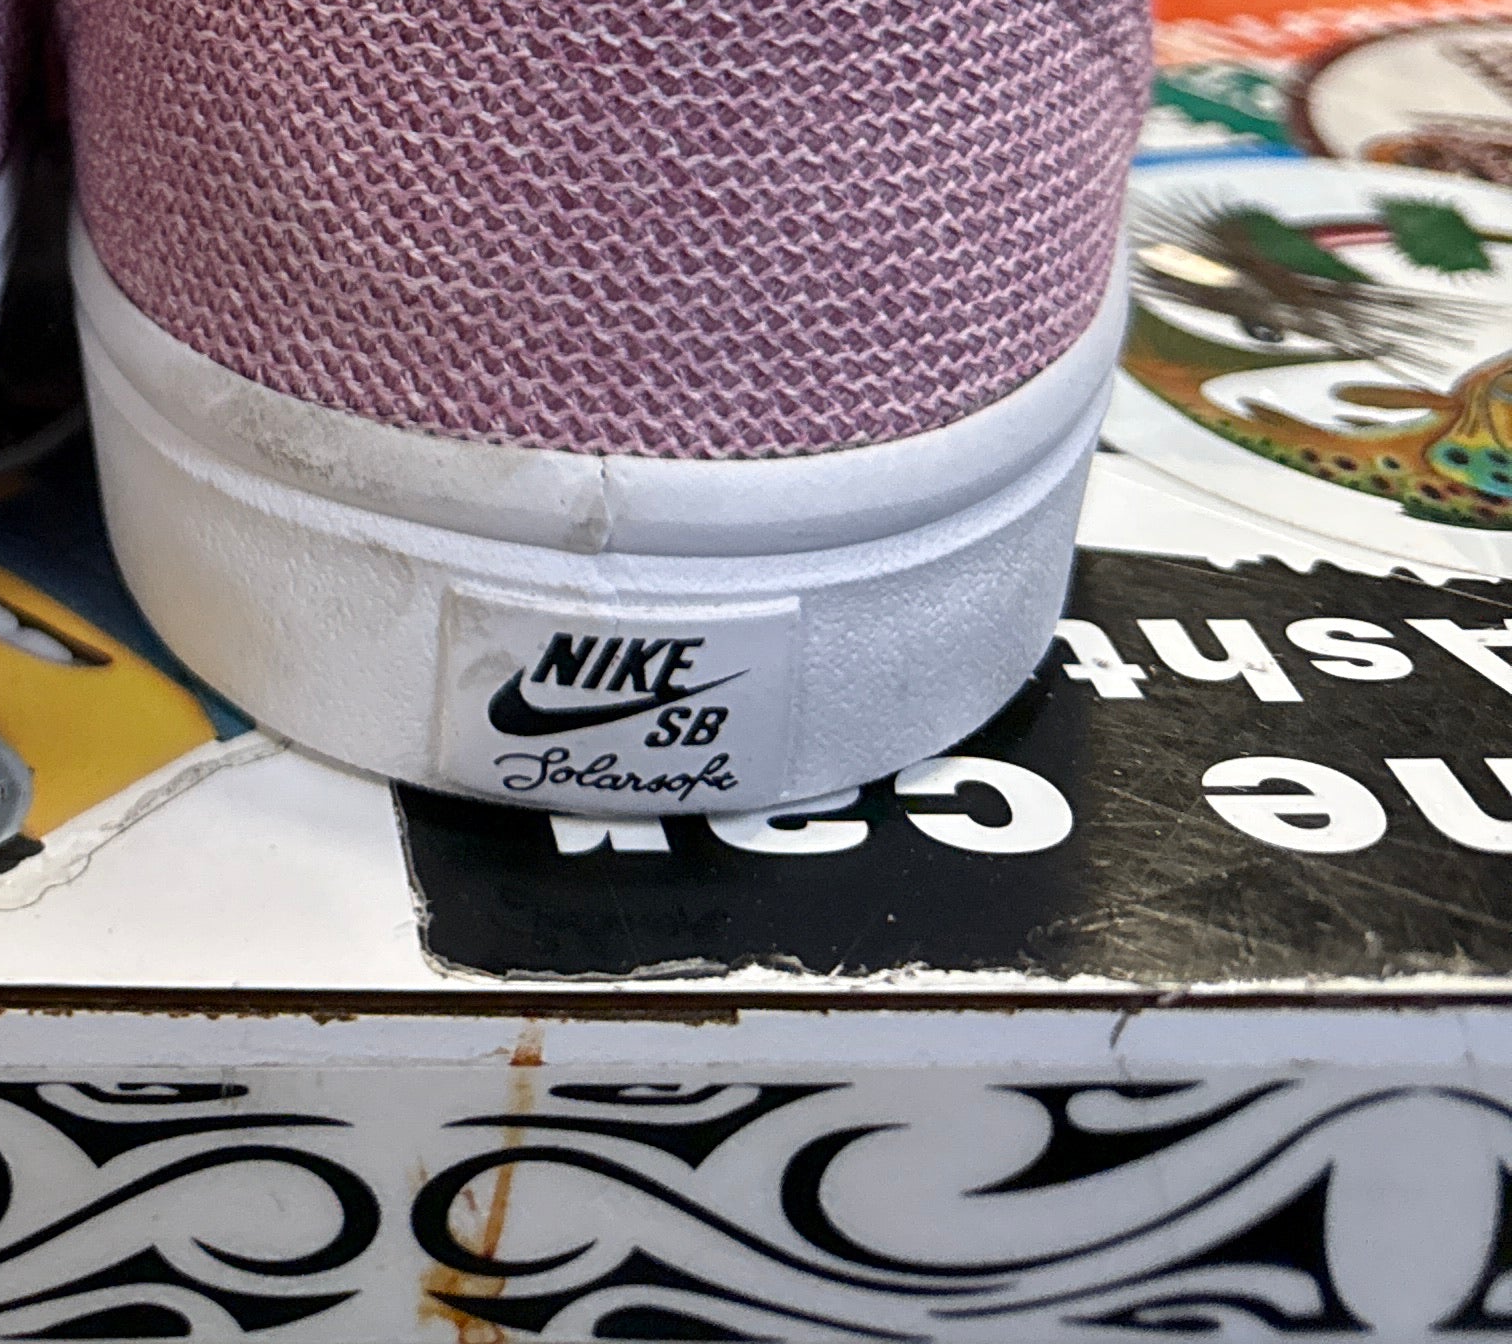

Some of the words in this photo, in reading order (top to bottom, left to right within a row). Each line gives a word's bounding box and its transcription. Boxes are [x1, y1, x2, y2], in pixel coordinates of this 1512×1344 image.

[531, 632, 705, 694] NIKE
[644, 707, 729, 747] SB
[494, 747, 738, 801] Solarsoft
